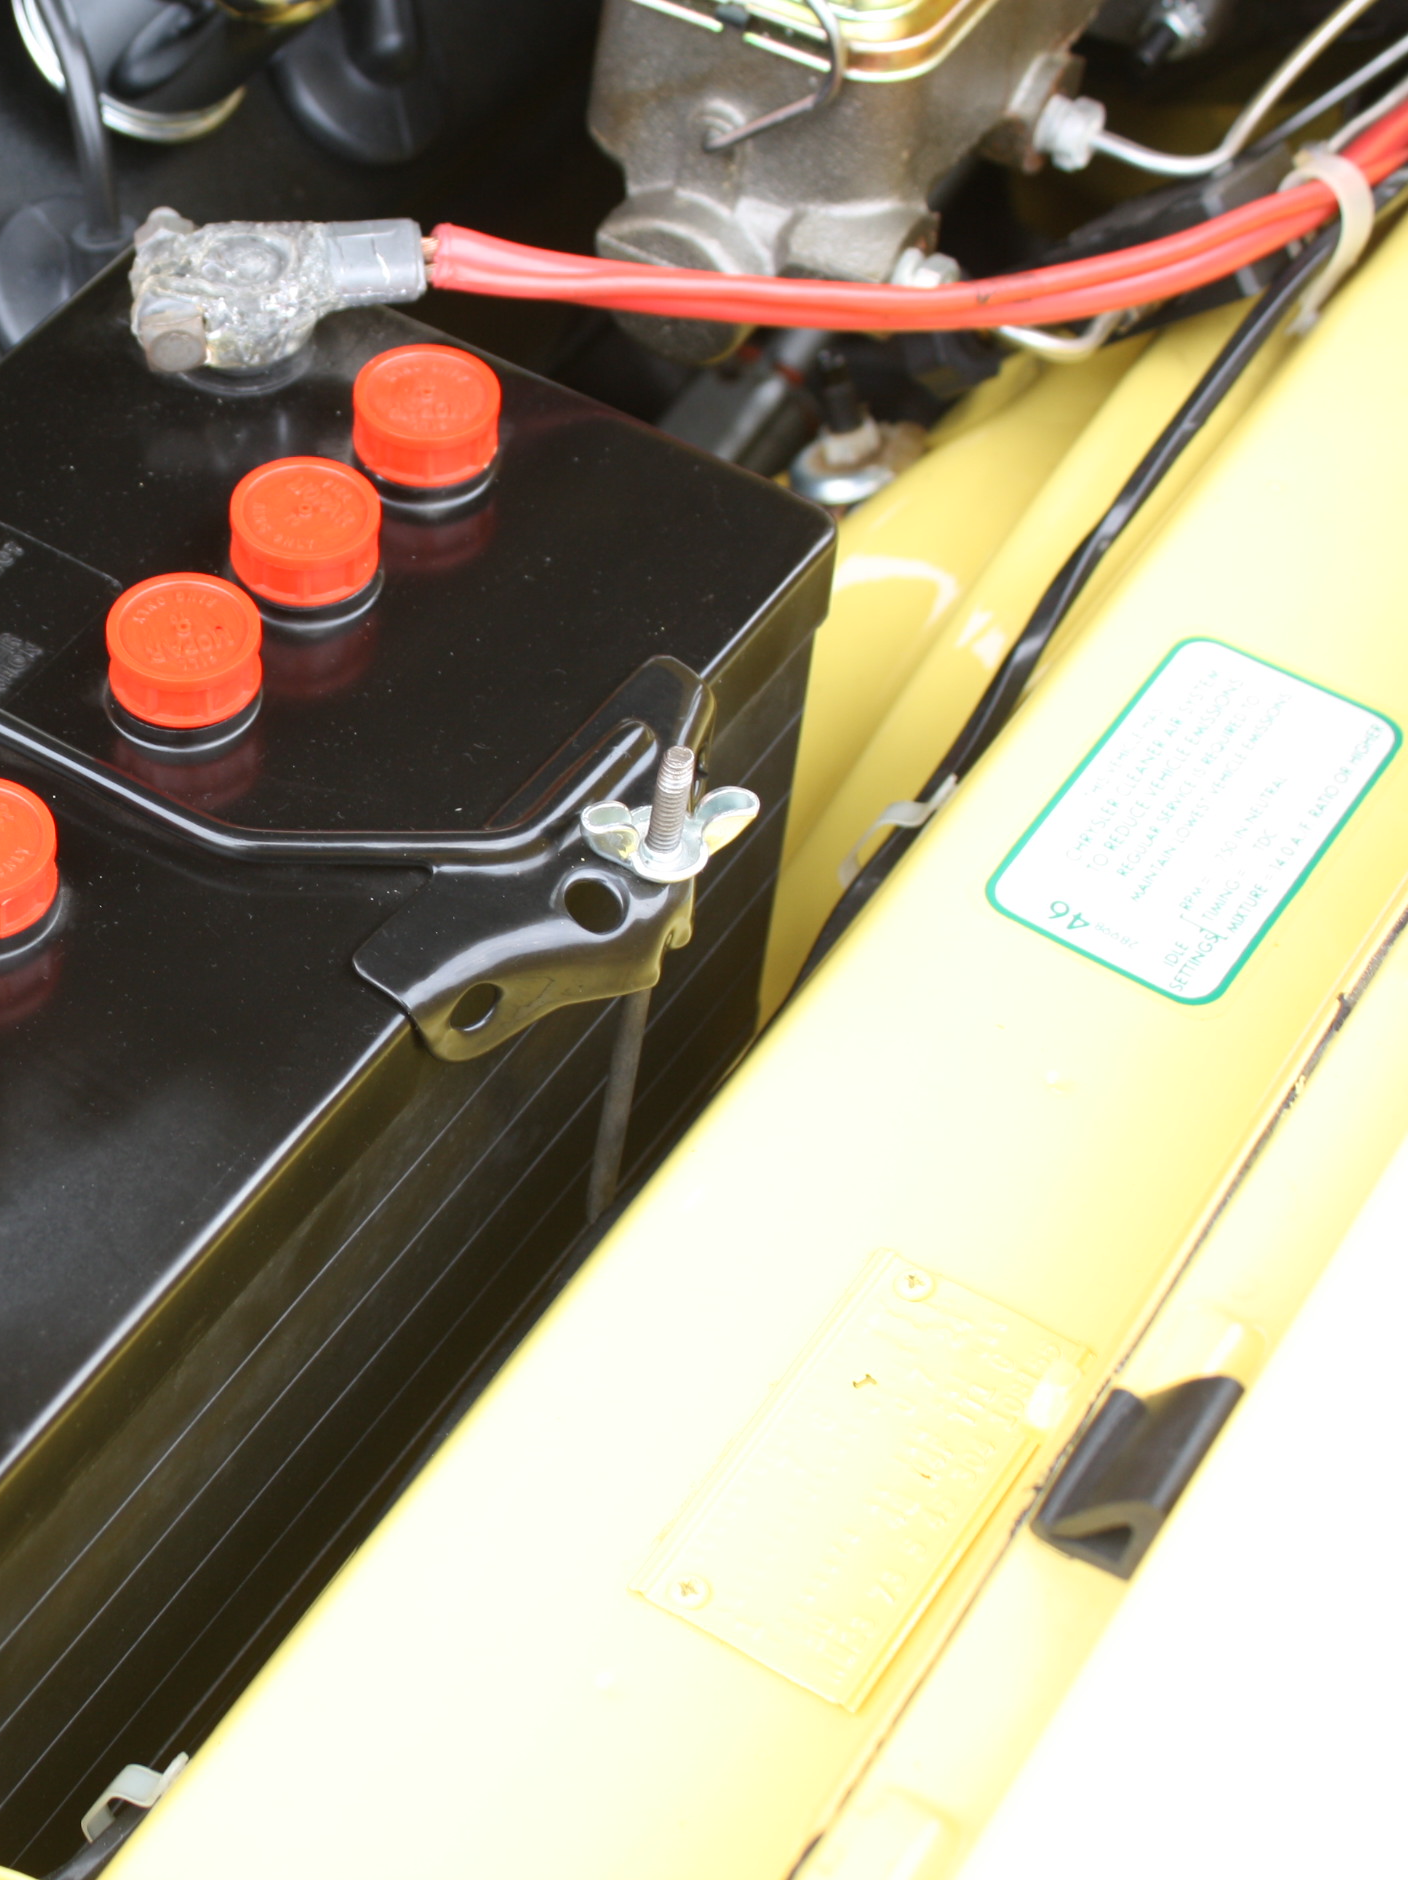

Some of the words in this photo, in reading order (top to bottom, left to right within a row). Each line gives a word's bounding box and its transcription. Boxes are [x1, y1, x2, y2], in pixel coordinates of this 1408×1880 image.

[1064, 797, 1120, 861] CHRYSLER
[1114, 738, 1166, 797] CLEANER
[1162, 715, 1185, 738] AIR
[1177, 668, 1220, 714] SYSTEM
[1085, 846, 1110, 872] TO
[1101, 798, 1152, 852] REDUCE
[1143, 745, 1192, 797] VEHICLE
[1182, 677, 1244, 746] EMISSIONS
[1114, 824, 1162, 880] REGULAR
[1154, 779, 1197, 825] SERVICE
[1191, 766, 1206, 778] IS
[1199, 713, 1247, 766] REQUIRED
[1128, 844, 1178, 903] MAINTAIN
[1174, 795, 1210, 844] LOWEST
[1208, 751, 1248, 795] VEHICLE
[1240, 692, 1293, 751] EMISSIONS
[1224, 882, 1271, 934] MIXTURE
[1305, 784, 1340, 819] RATIO
[1332, 764, 1354, 785] OR
[1346, 722, 1390, 766] HIGHER
[1048, 900, 1090, 930] 46
[1177, 885, 1205, 912] RPM
[1231, 824, 1249, 840] IN
[1242, 775, 1288, 824] NEUTRAL
[1200, 878, 1241, 921] TIMING
[1250, 828, 1278, 850] TDC
[1161, 939, 1191, 968] IDLE
[1168, 932, 1219, 992] SETTINGS
